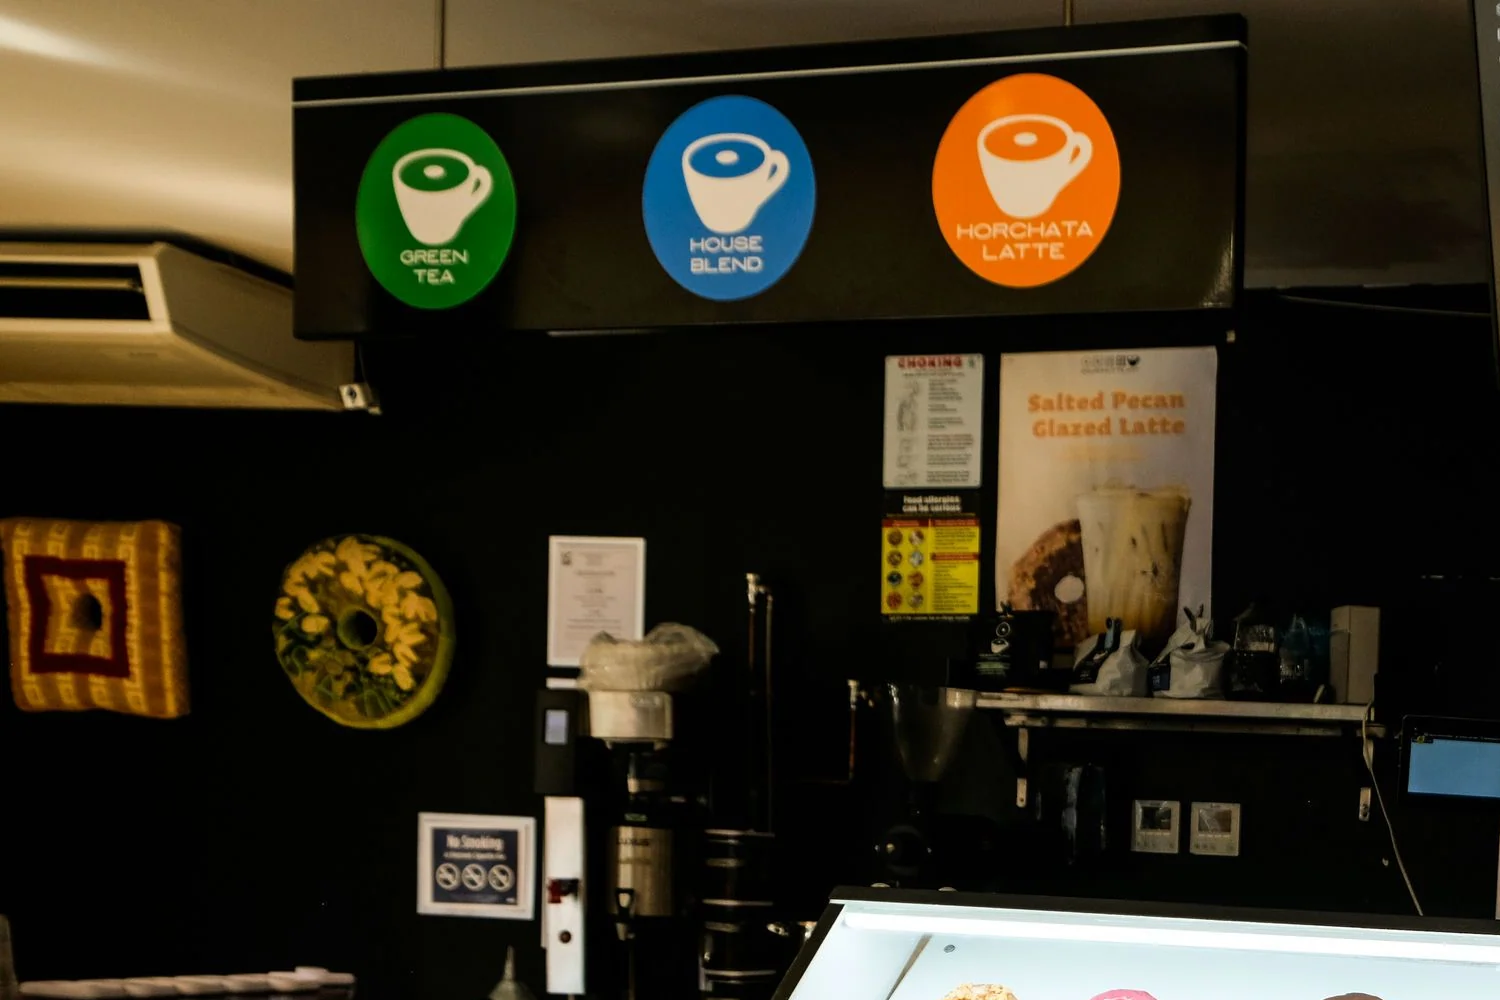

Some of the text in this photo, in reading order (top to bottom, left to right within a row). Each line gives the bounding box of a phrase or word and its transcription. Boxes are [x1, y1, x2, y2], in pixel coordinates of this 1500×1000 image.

[956, 220, 1094, 242] HORCHATA
[689, 236, 763, 254] HOUSE
[982, 242, 1065, 261] LATTE
[400, 249, 468, 266] GREEN
[690, 256, 763, 274] BLEND
[414, 269, 454, 285] TEA
[898, 357, 963, 369] CHOKING
[1027, 391, 1185, 413] Salted Pecan
[1032, 417, 1186, 438] Glazed Latte
